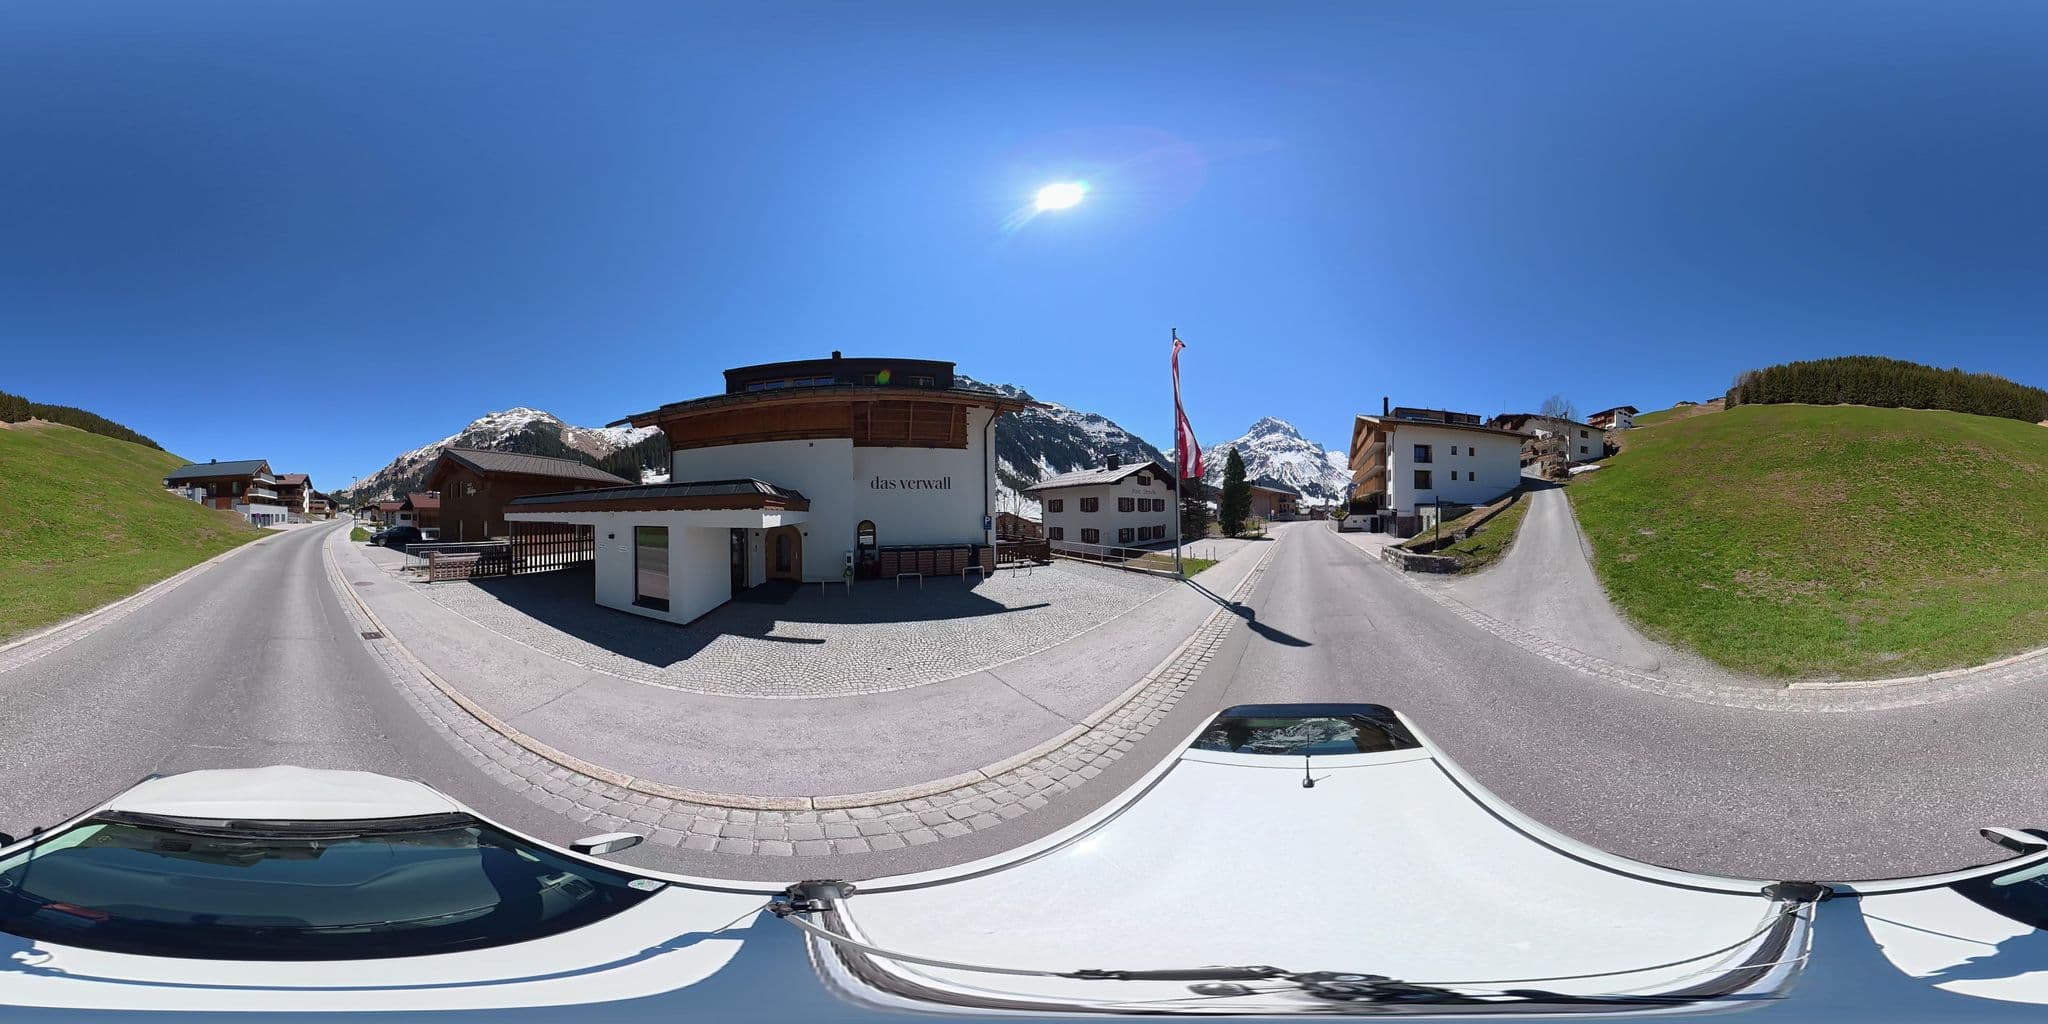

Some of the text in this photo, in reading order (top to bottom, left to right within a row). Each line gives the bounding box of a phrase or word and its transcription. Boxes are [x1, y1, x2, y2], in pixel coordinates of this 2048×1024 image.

[870, 476, 952, 490] das verwall
[984, 516, 991, 525] P
